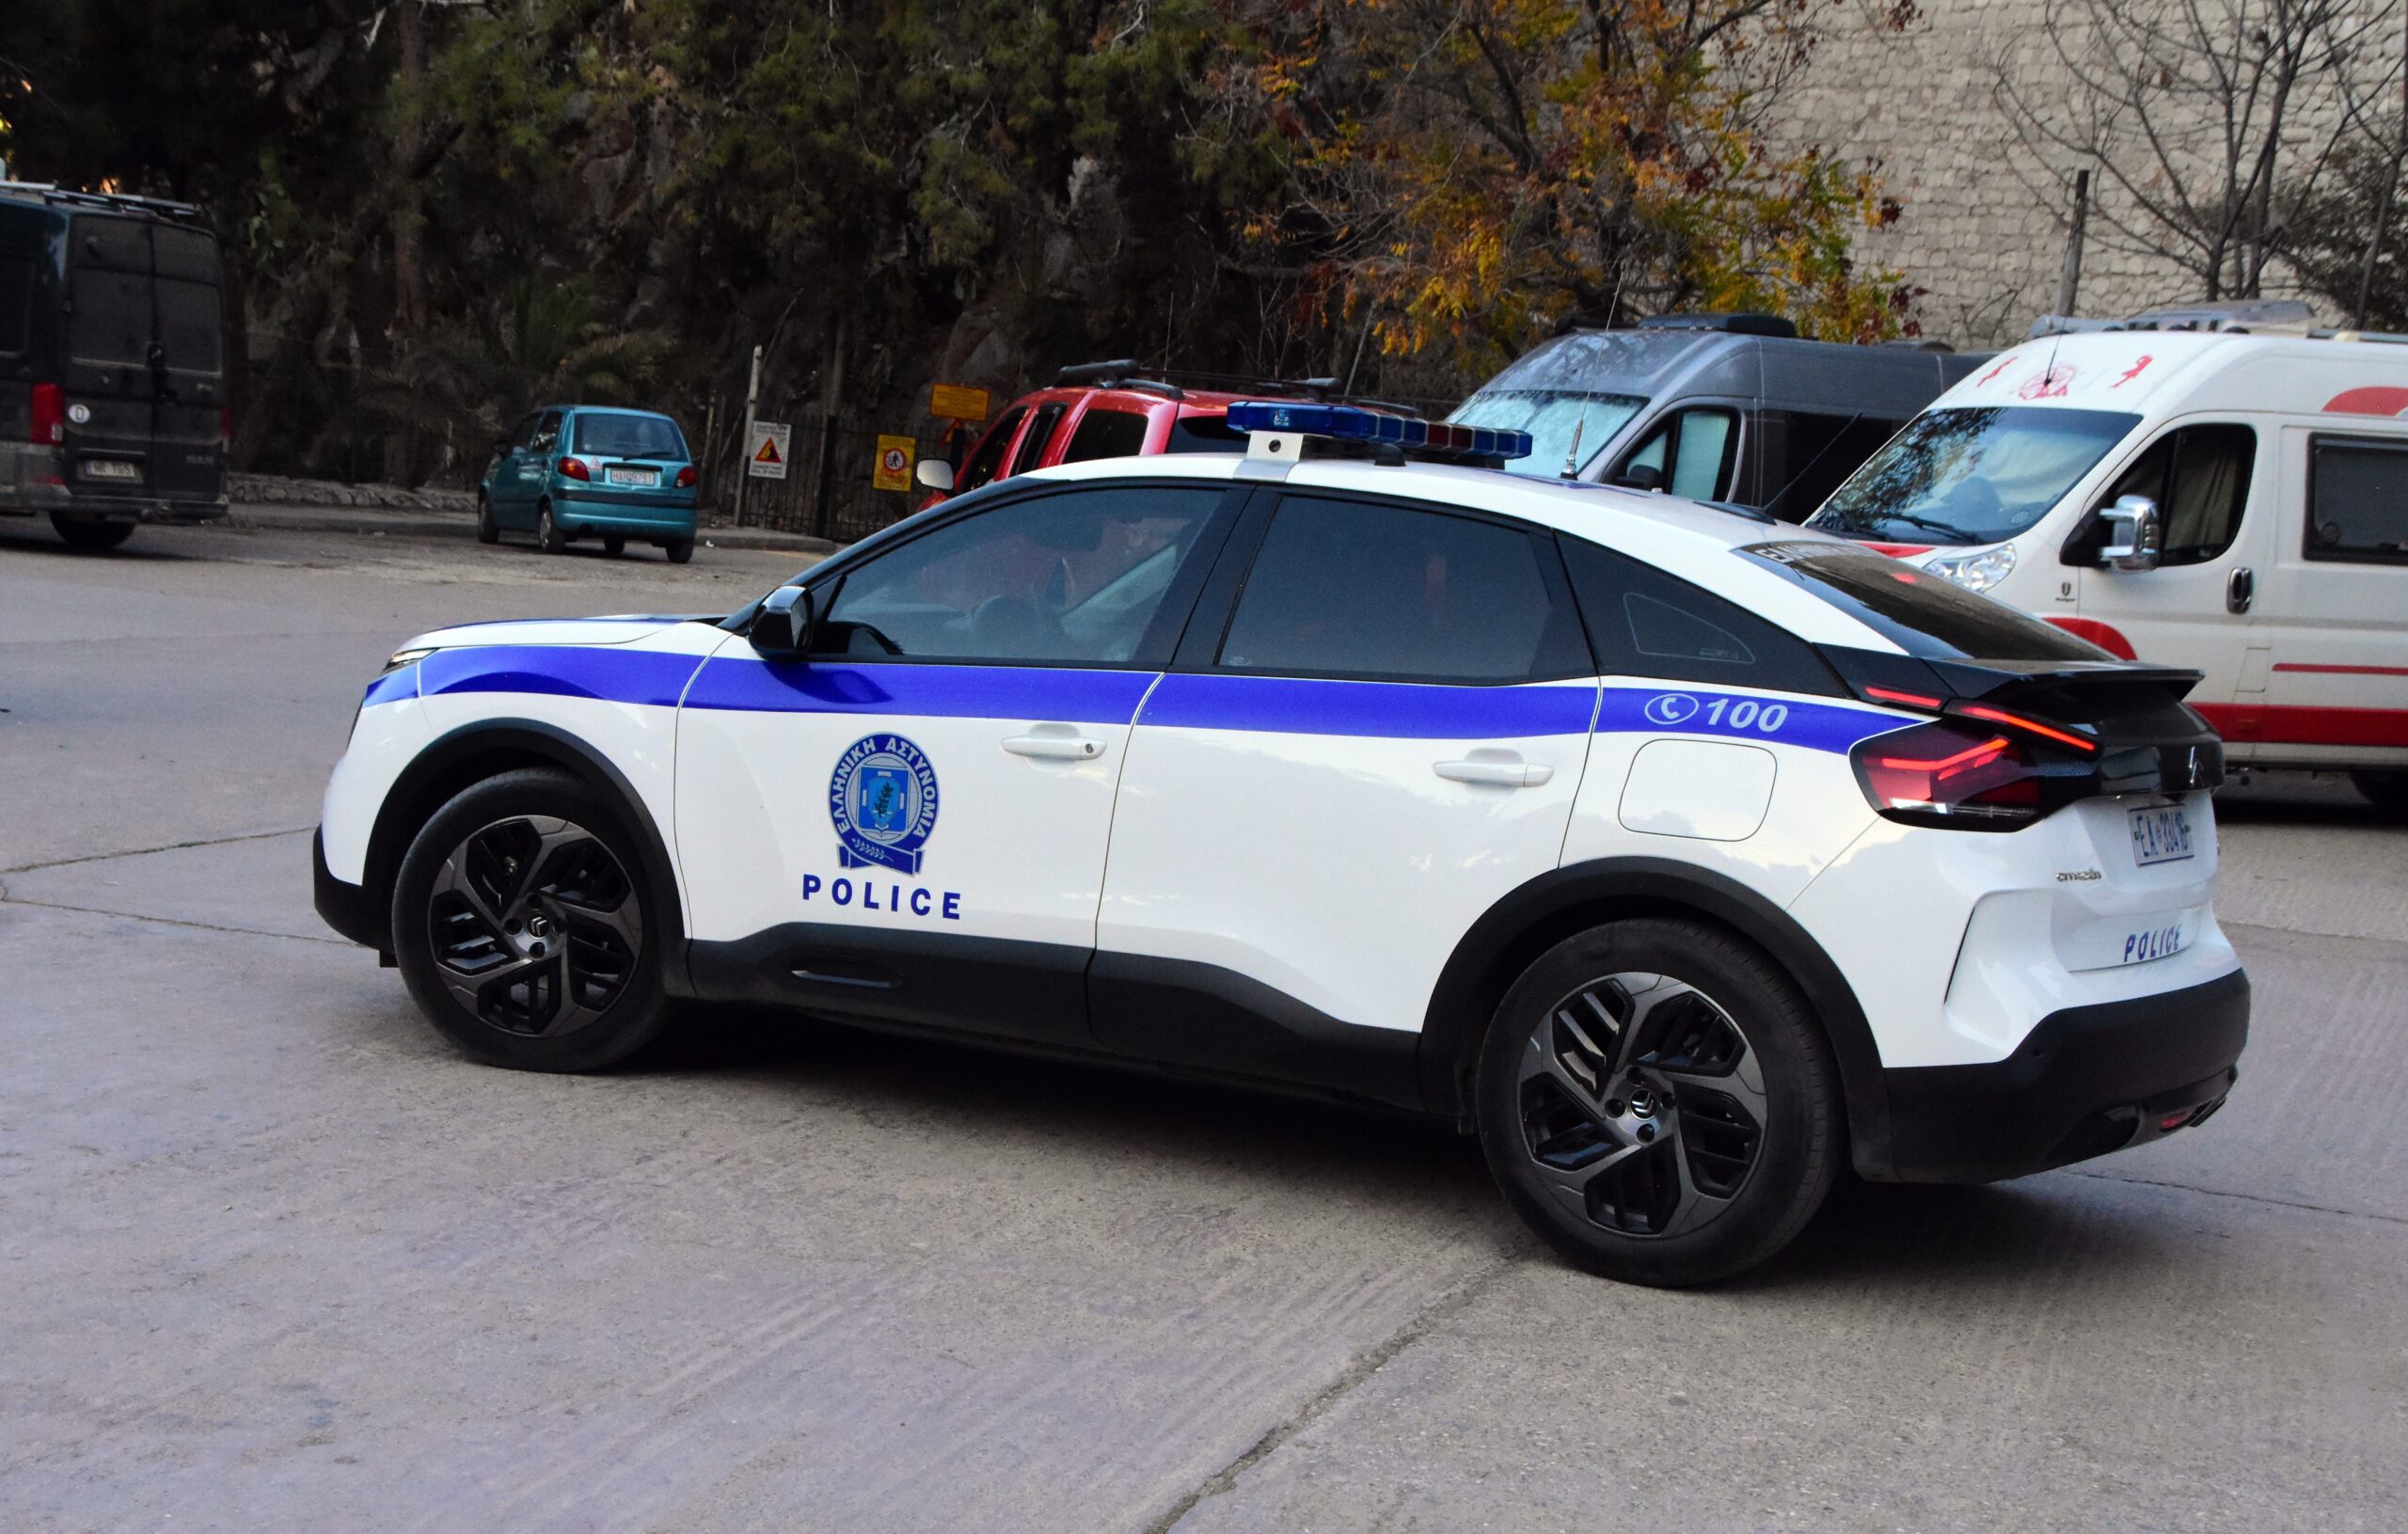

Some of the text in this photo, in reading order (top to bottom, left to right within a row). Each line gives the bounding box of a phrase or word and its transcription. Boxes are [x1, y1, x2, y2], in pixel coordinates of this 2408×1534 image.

[1707, 698, 1788, 732] 100
[832, 736, 936, 838] ΕΛΛΗΝΙΚΗ ΑΣΤΥΝΟΜΙΑ
[802, 874, 961, 920] POLICE
[2124, 924, 2182, 962] POLICE
